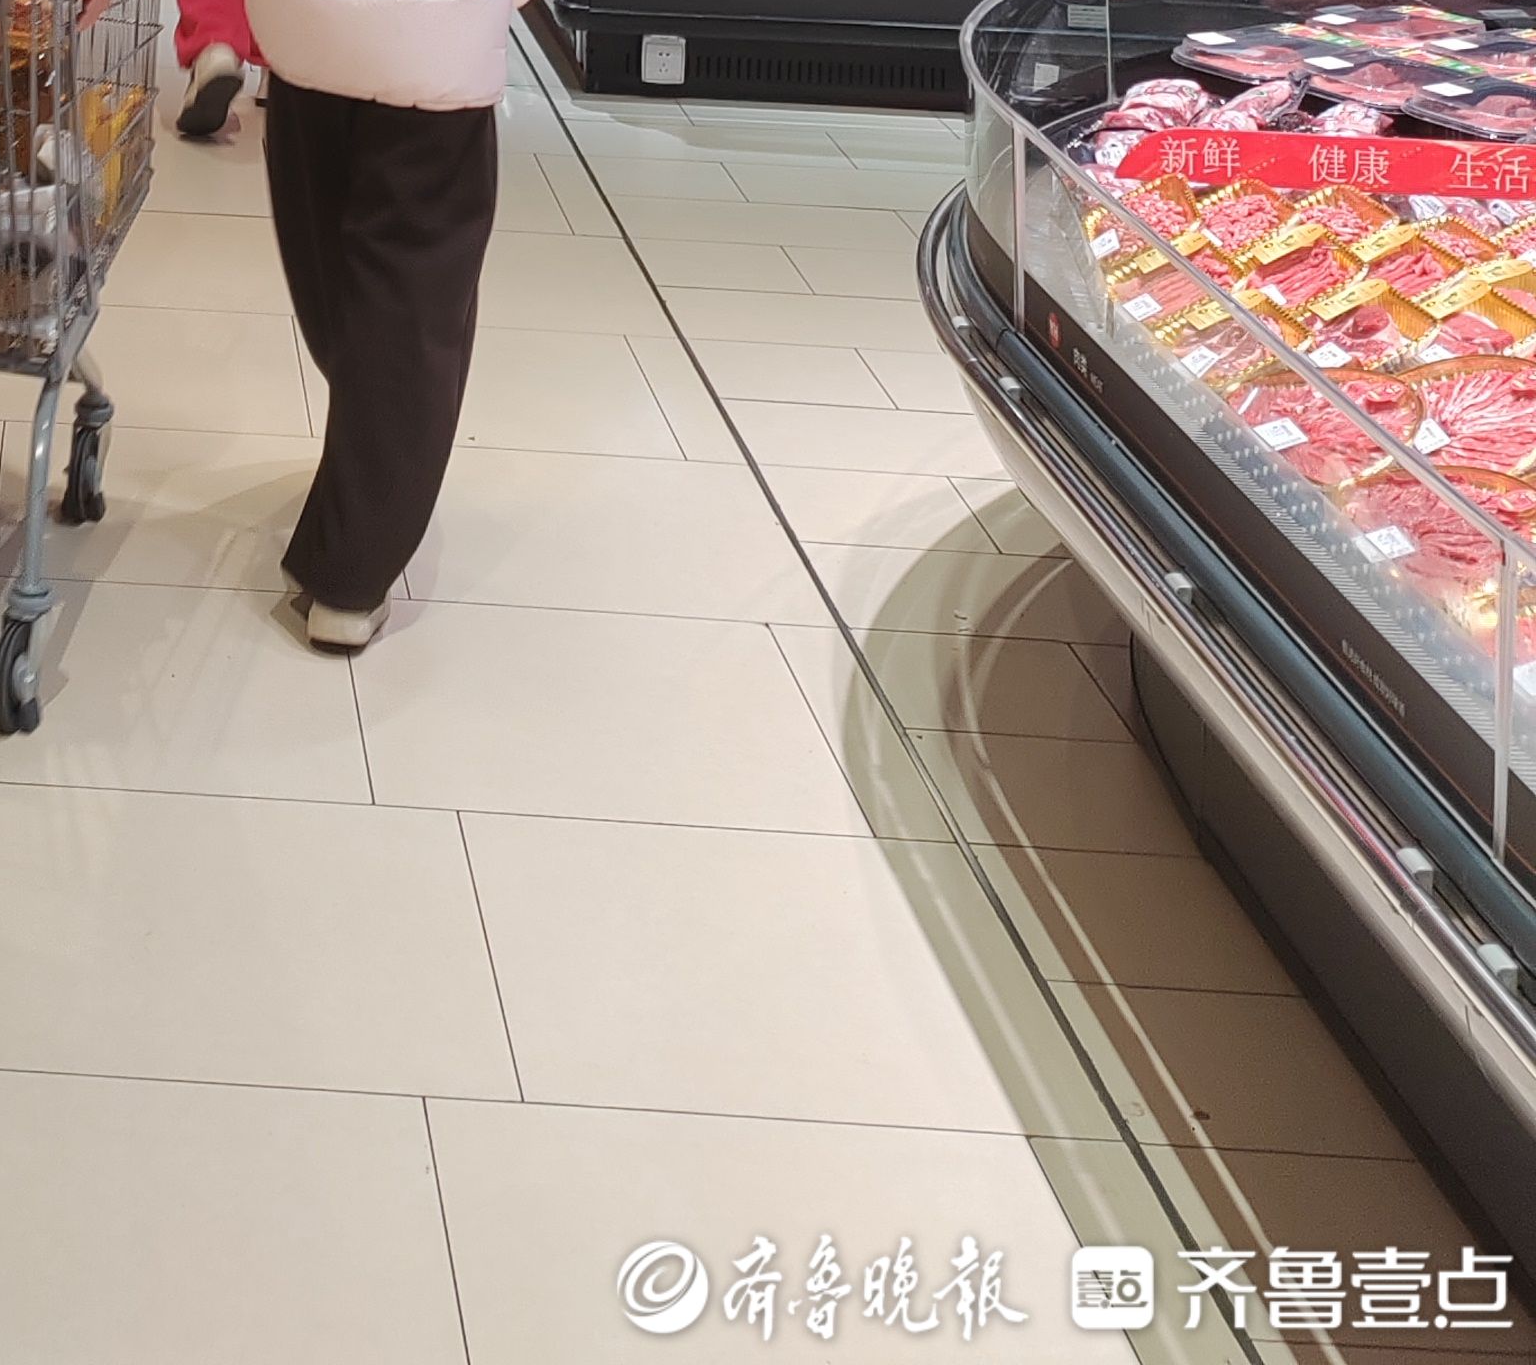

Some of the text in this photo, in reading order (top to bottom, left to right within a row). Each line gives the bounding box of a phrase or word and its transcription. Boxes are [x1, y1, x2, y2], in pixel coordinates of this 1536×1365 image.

[1158, 134, 1531, 195] 新鲜 健康 生活
